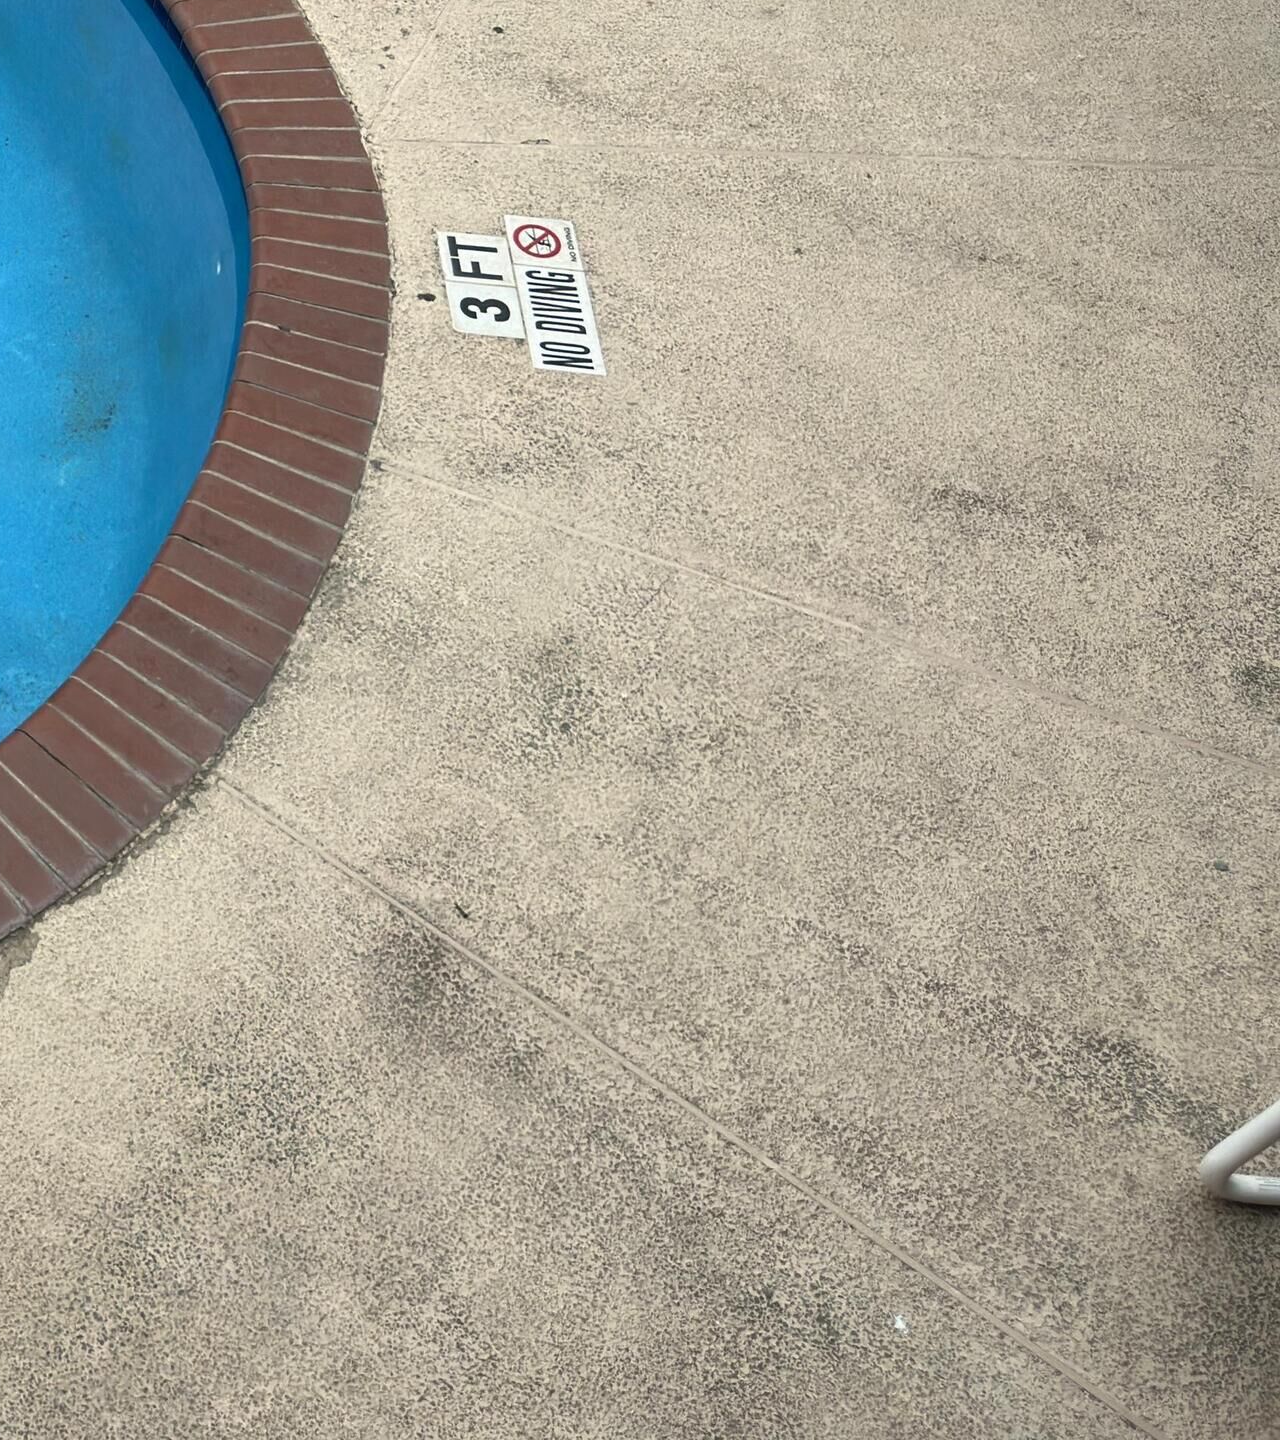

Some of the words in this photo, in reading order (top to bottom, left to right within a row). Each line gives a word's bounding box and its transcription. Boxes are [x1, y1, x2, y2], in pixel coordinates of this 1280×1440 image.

[564, 227, 575, 250] DIVING
[446, 235, 503, 281] FT
[569, 251, 577, 262] NO
[460, 296, 511, 323] 3
[525, 269, 587, 335] DIVING
[539, 340, 595, 370] NO
